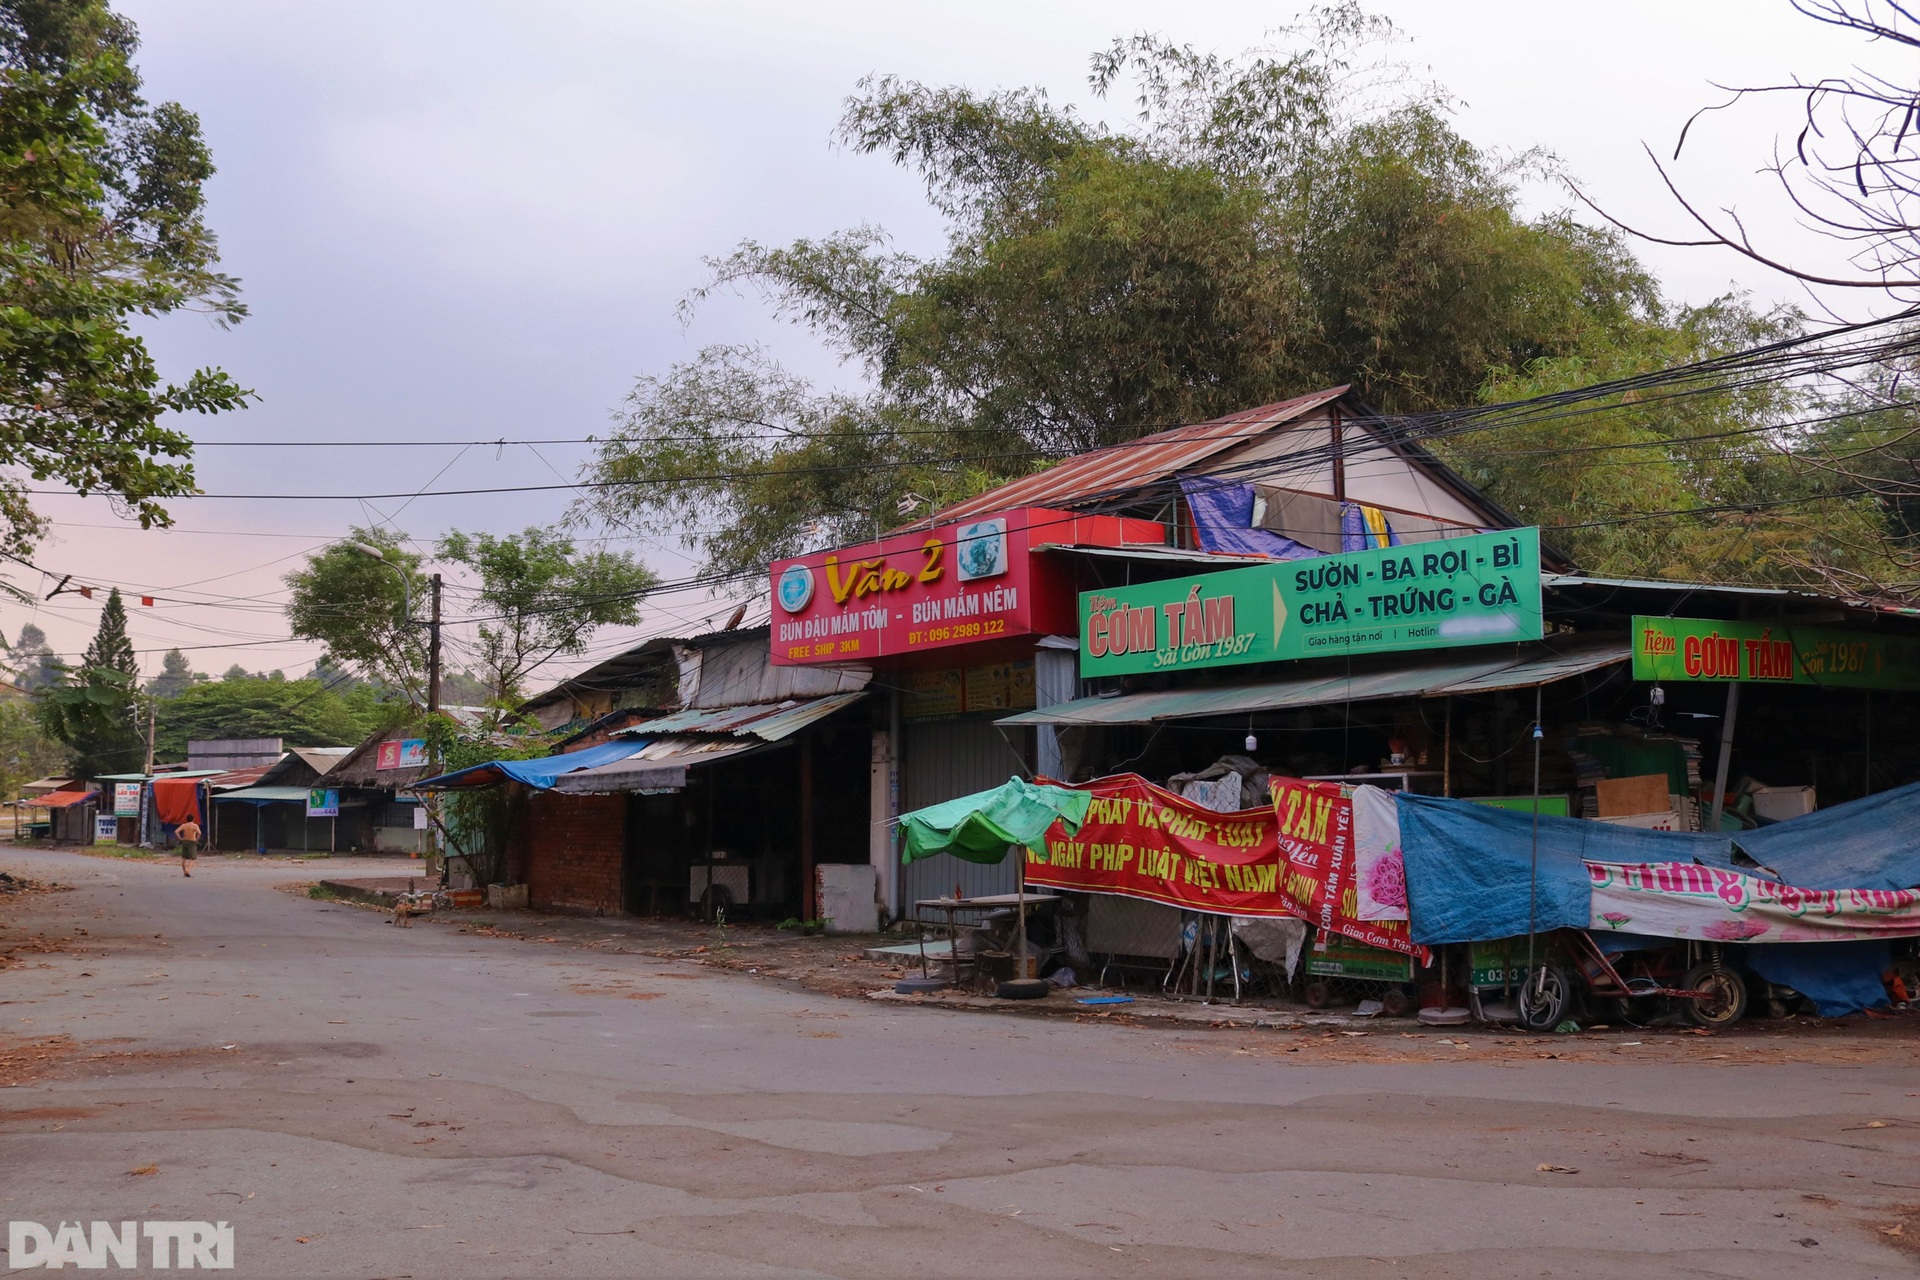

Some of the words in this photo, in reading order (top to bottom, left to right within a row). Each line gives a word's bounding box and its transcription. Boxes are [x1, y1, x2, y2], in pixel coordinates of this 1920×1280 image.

[825, 555, 914, 604] Văn
[918, 539, 944, 582] 2
[1295, 562, 1358, 591] SƯỜN
[1382, 557, 1416, 581] BA
[1423, 550, 1467, 580] RỌI
[1493, 537, 1520, 568] BÌ
[779, 617, 803, 642] BÚN
[805, 613, 829, 642] ĐẬU
[831, 606, 860, 635] MẮM
[861, 604, 888, 631] TÔM
[912, 595, 940, 624] BÚN
[944, 586, 979, 619] MẮM
[983, 584, 1017, 614] NÊM
[1300, 592, 1348, 624] CHẢ
[1368, 586, 1454, 618] TRỨNG
[1478, 576, 1518, 606] GÀ
[929, 626, 950, 642] 096
[952, 622, 981, 639] 2989
[983, 619, 1004, 635] 122
[1088, 603, 1157, 658] CƠM
[1164, 584, 1235, 649] TẤM
[1308, 637, 1327, 647] Giao
[1328, 634, 1351, 645] hàng
[1352, 632, 1367, 644] tận
[1368, 630, 1383, 641] nơi
[788, 645, 810, 659] FREE
[815, 642, 835, 656] SHIP
[840, 639, 860, 653] 3KM
[1153, 646, 1180, 668] Sài
[1181, 640, 1212, 663] Gòn
[1214, 632, 1258, 658] 1987
[1643, 629, 1676, 656] Tiệm
[1684, 632, 1739, 677] CƠM
[1744, 627, 1793, 679] TẤM
[1829, 640, 1869, 674] 1987
[1086, 792, 1132, 825] PHÁP
[1138, 796, 1159, 830] VÀ
[1336, 805, 1350, 832] YẾN
[1051, 836, 1086, 869] NGÀY
[1090, 838, 1134, 871] PHÁP
[1137, 845, 1181, 885] LUẬT
[1184, 854, 1221, 894] VIỆT
[1223, 863, 1278, 893] NAM
[1331, 835, 1346, 870] XUÂN
[1324, 872, 1339, 900] TẤM
[1320, 902, 1333, 930] CƠM
[1342, 923, 1365, 940] Giao
[1366, 931, 1389, 947] Cơm
[1392, 938, 1412, 953] Tận
